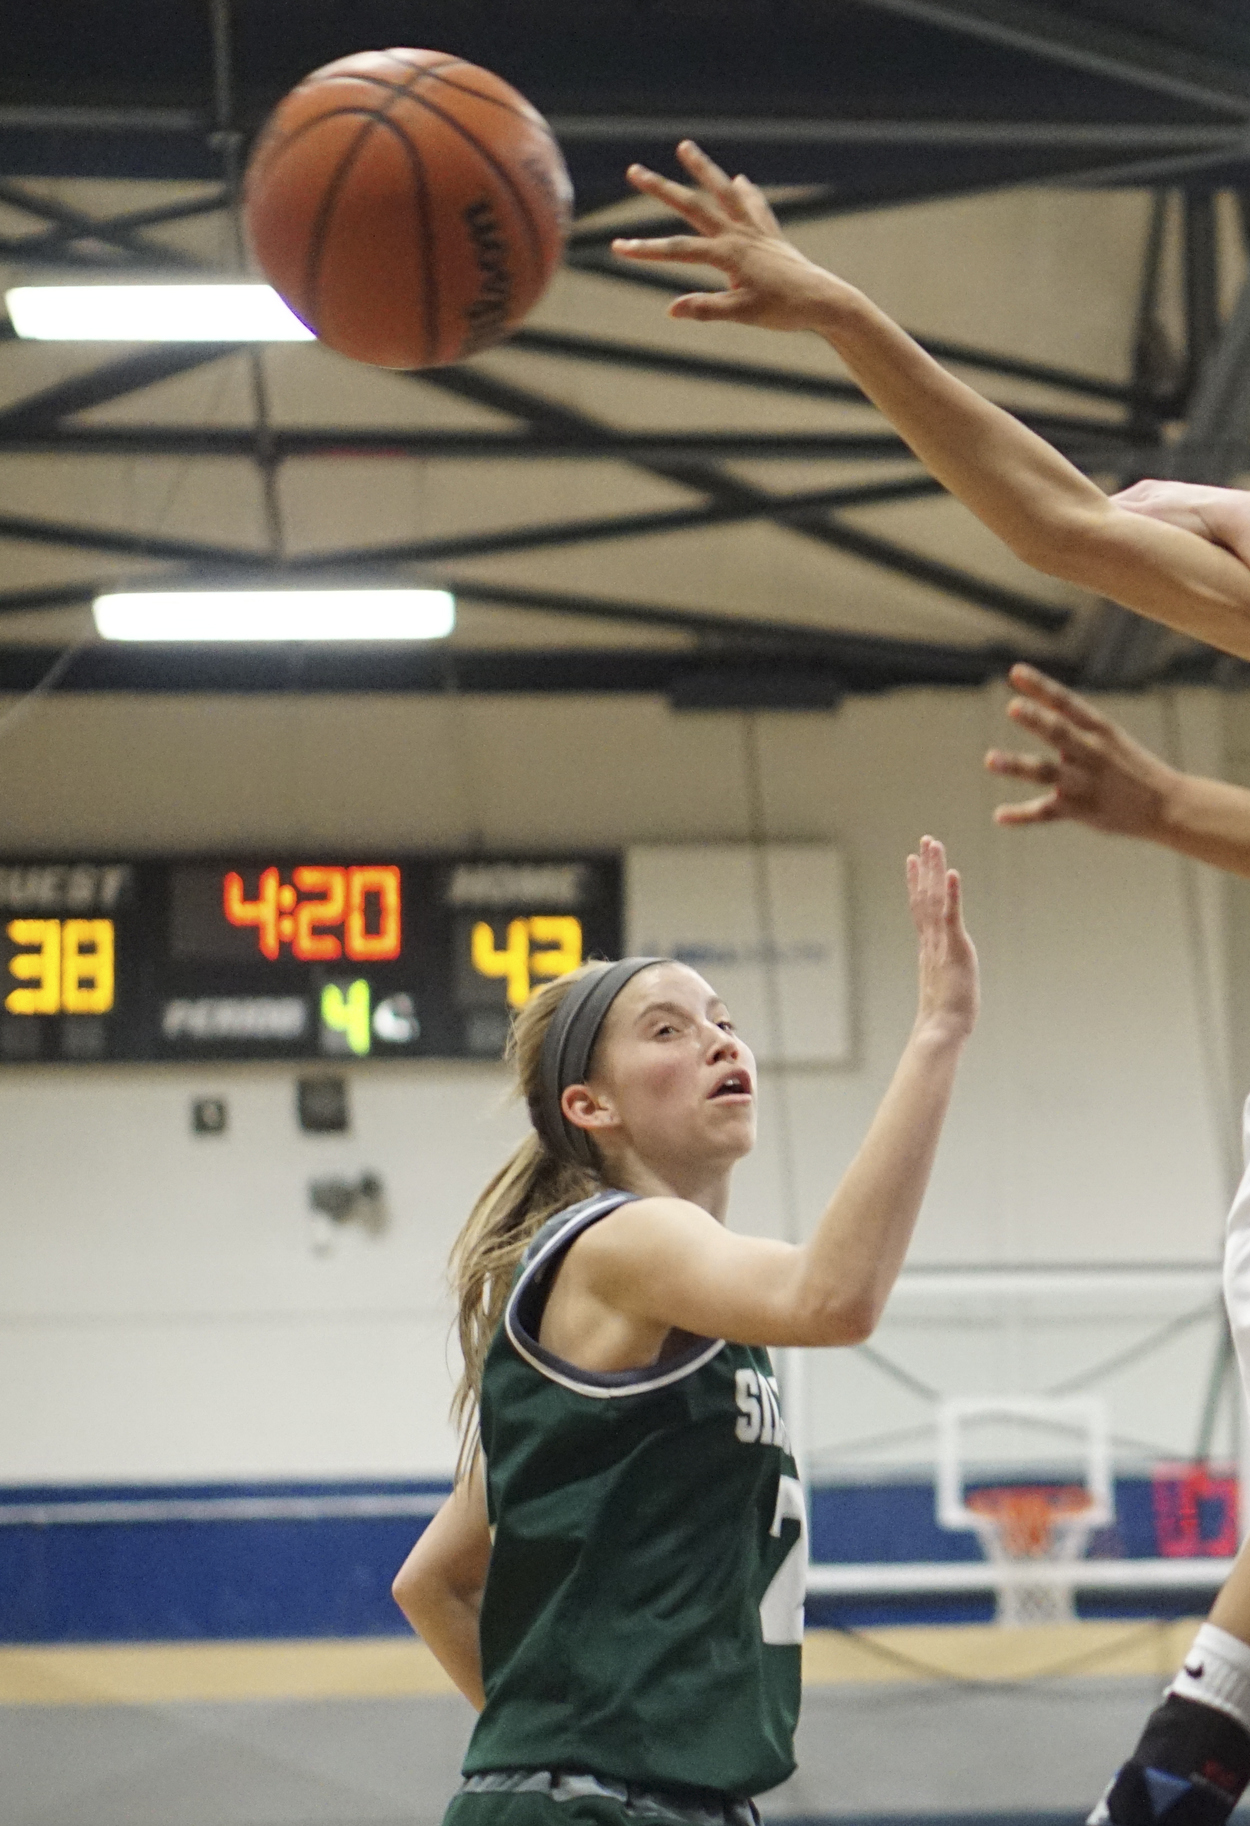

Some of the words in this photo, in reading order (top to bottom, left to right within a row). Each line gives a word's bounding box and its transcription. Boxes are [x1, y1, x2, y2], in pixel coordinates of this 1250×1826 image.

[0, 866, 132, 908] UEST
[222, 865, 401, 961] 4:20
[5, 918, 115, 1015] 38
[471, 915, 584, 1011] 43
[321, 979, 370, 1055] 4
